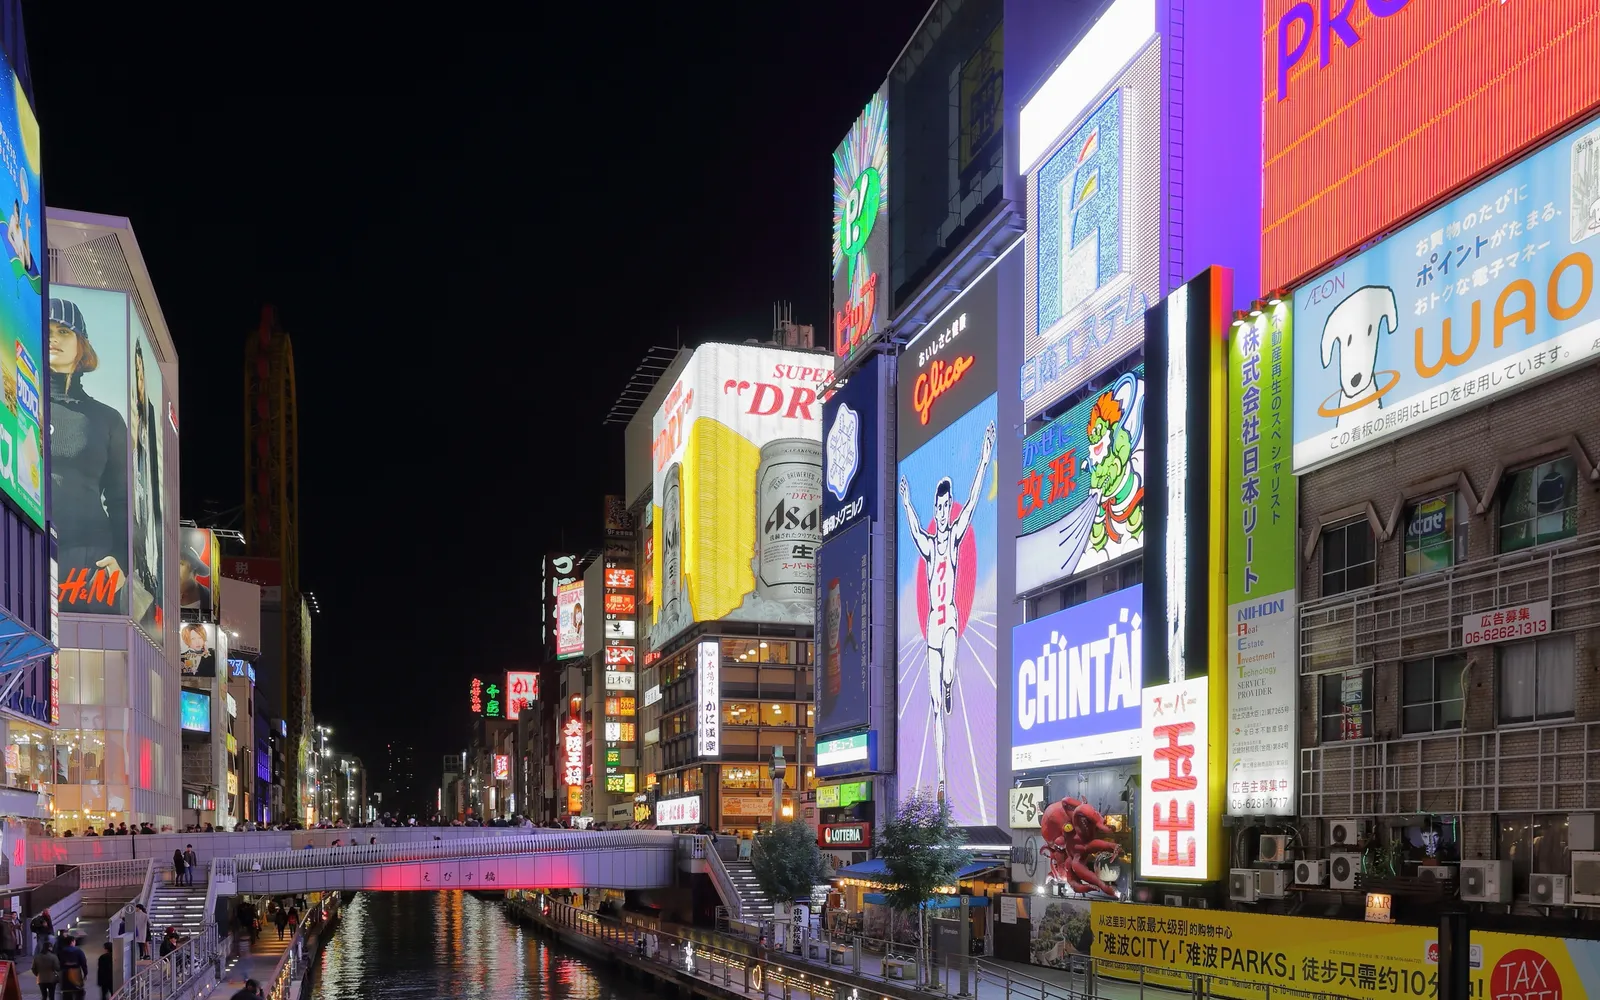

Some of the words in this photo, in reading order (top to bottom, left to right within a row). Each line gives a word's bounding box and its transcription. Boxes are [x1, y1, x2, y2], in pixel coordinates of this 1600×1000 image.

[1416, 184, 1528, 257] お買物のたびに
[1416, 202, 1562, 288] ポイントがたまる、
[1414, 240, 1551, 316] おトクな電子マネー
[836, 272, 877, 357] ピップ
[918, 313, 966, 368] おいしさと健康
[914, 355, 975, 426] Glico
[1330, 344, 1570, 449] この看板の照明はLEDを使用しています。
[1271, 314, 1282, 525] 不動産再生のスペシャリスト
[1022, 422, 1073, 467] かぜに
[1242, 326, 1260, 594] 株式会社日本リート
[1017, 449, 1076, 519] 改源
[822, 496, 864, 536] 雪印メグミルク
[792, 544, 814, 560] 生
[58, 568, 120, 606] H&M
[794, 586, 812, 594] 350ml
[935, 556, 948, 627] グリコ
[1238, 598, 1284, 622] NIHON
[1480, 608, 1530, 627] 広告募集
[1238, 623, 1258, 636] Real
[1465, 620, 1548, 644] 06-6262-1313
[1238, 638, 1264, 650] Estate
[1238, 651, 1276, 665] Investment
[607, 674, 632, 685] 白木屋
[1018, 620, 1142, 730] CHINTAI
[1237, 666, 1276, 678] Technology
[1238, 678, 1266, 690] SERVICE
[1153, 690, 1197, 717] スーパー
[1238, 687, 1272, 699] PROVIDER
[1151, 721, 1198, 866] 玉出
[1232, 779, 1288, 794] 広告主募集中
[1232, 798, 1288, 810] 06-6281-1717
[832, 828, 861, 842] LOTTERIA
[1366, 895, 1391, 909] BAR
[1098, 914, 1232, 940] 从这里到大阪最大级别的购物中心
[1500, 958, 1548, 991] TAX
